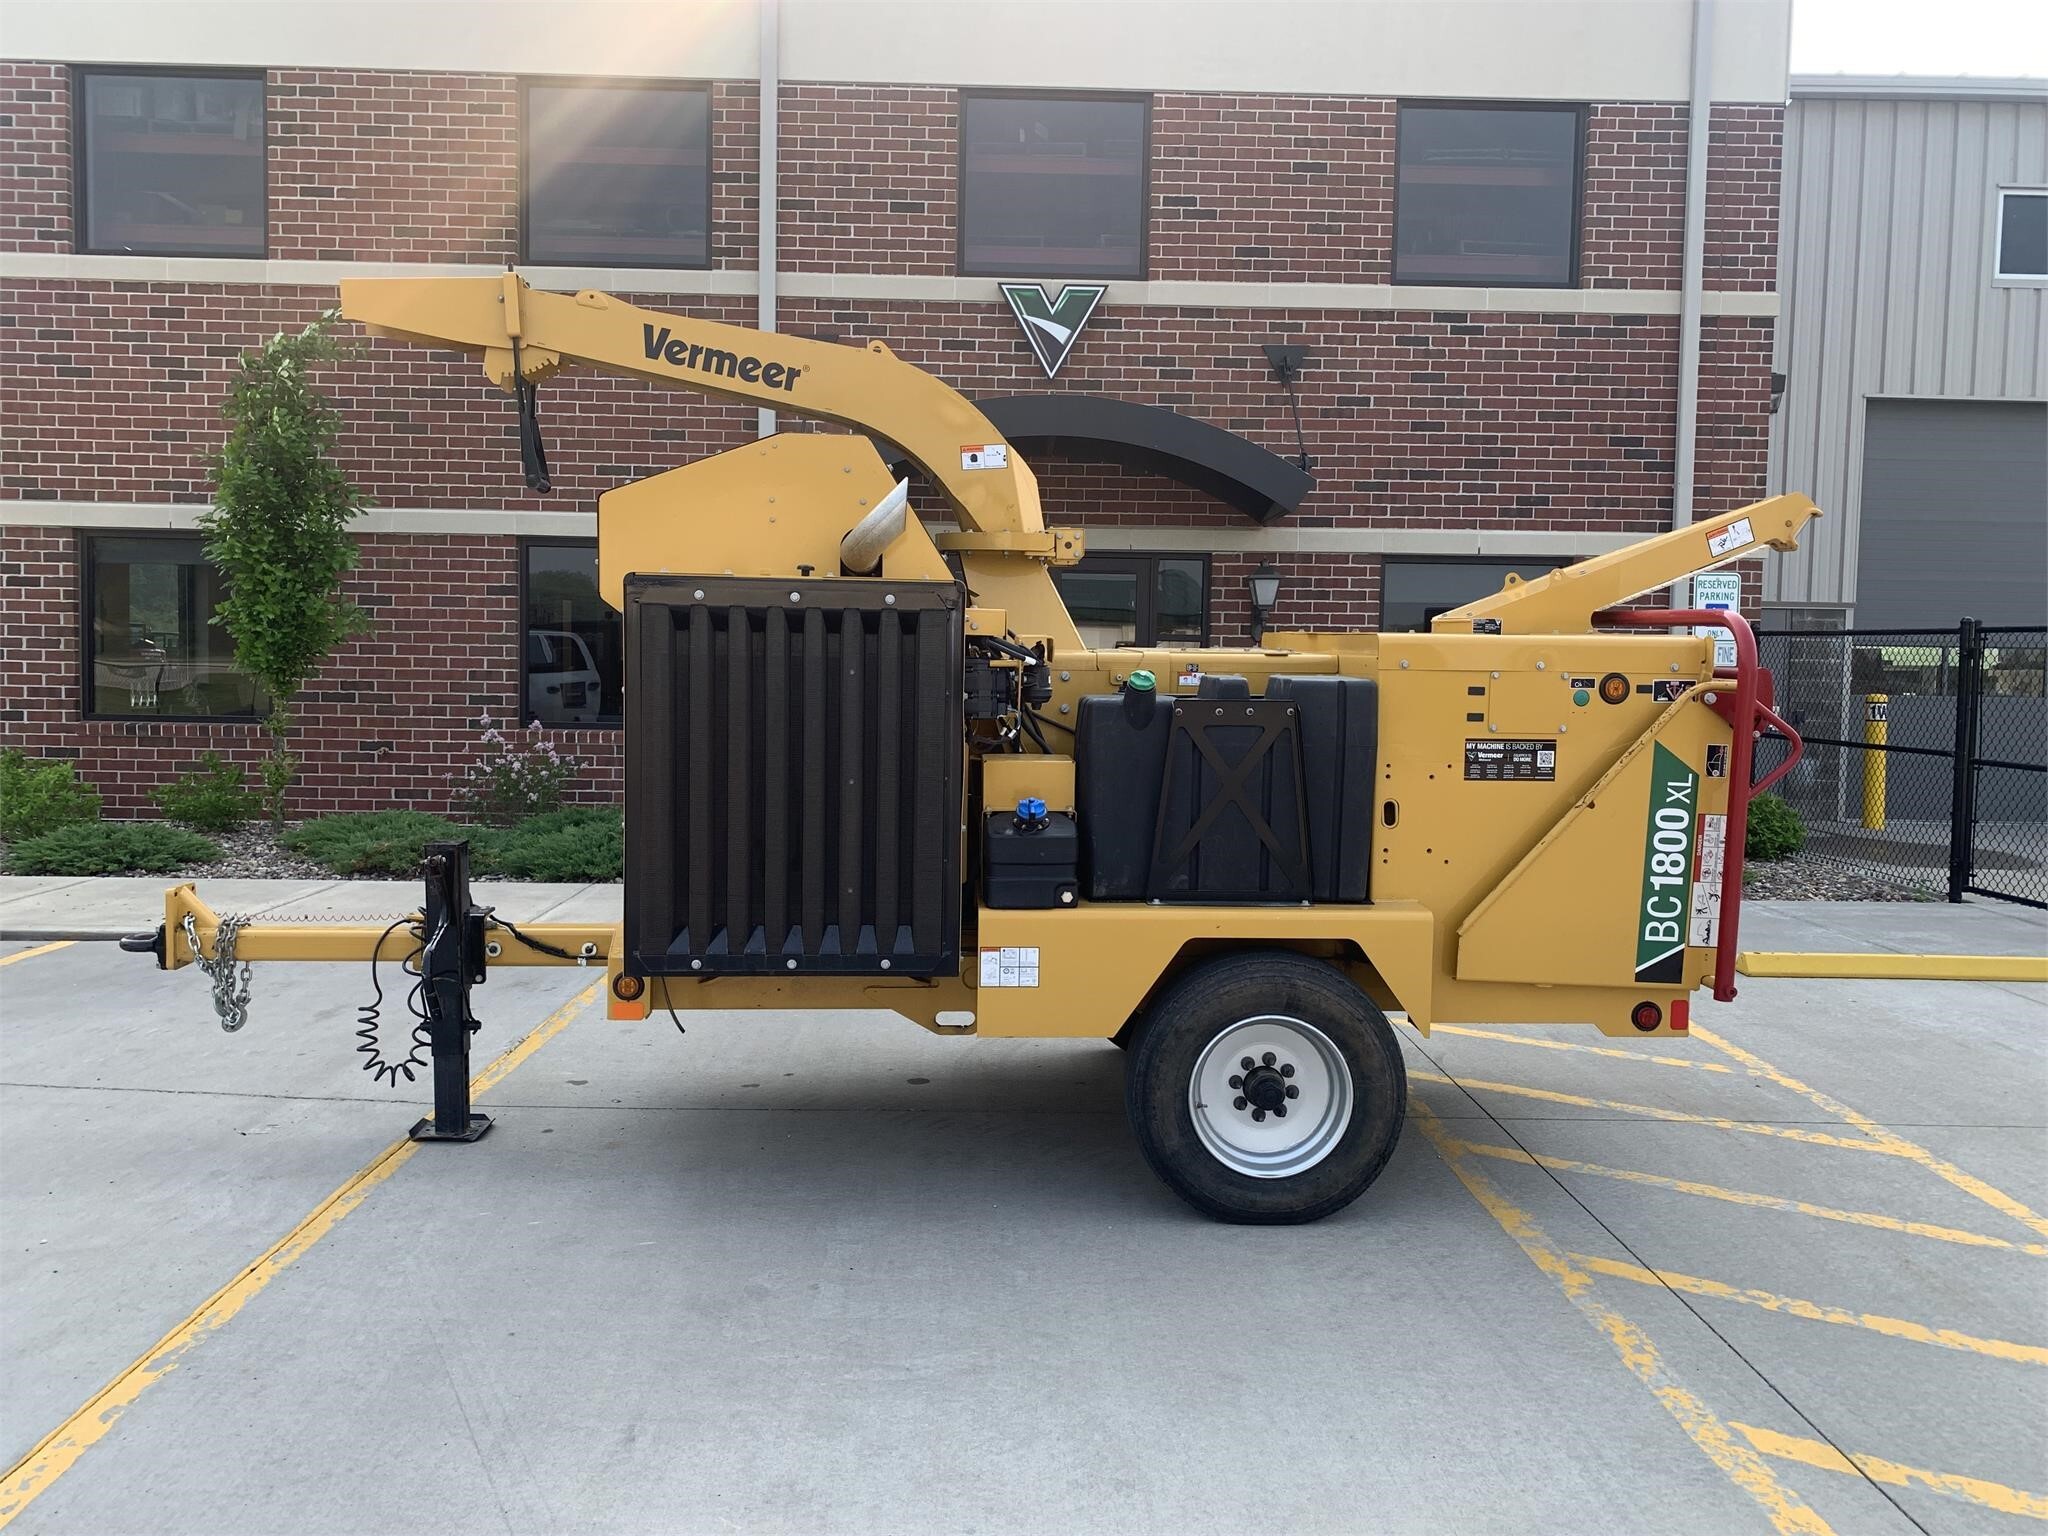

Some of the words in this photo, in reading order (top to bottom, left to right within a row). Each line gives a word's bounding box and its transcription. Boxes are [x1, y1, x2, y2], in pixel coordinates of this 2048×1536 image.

[643, 323, 802, 392] Vermeer
[1697, 579, 1738, 590] RESERVED
[1699, 592, 1735, 601] PARKING
[1707, 629, 1724, 637] ONLY
[1717, 647, 1734, 663] FINE
